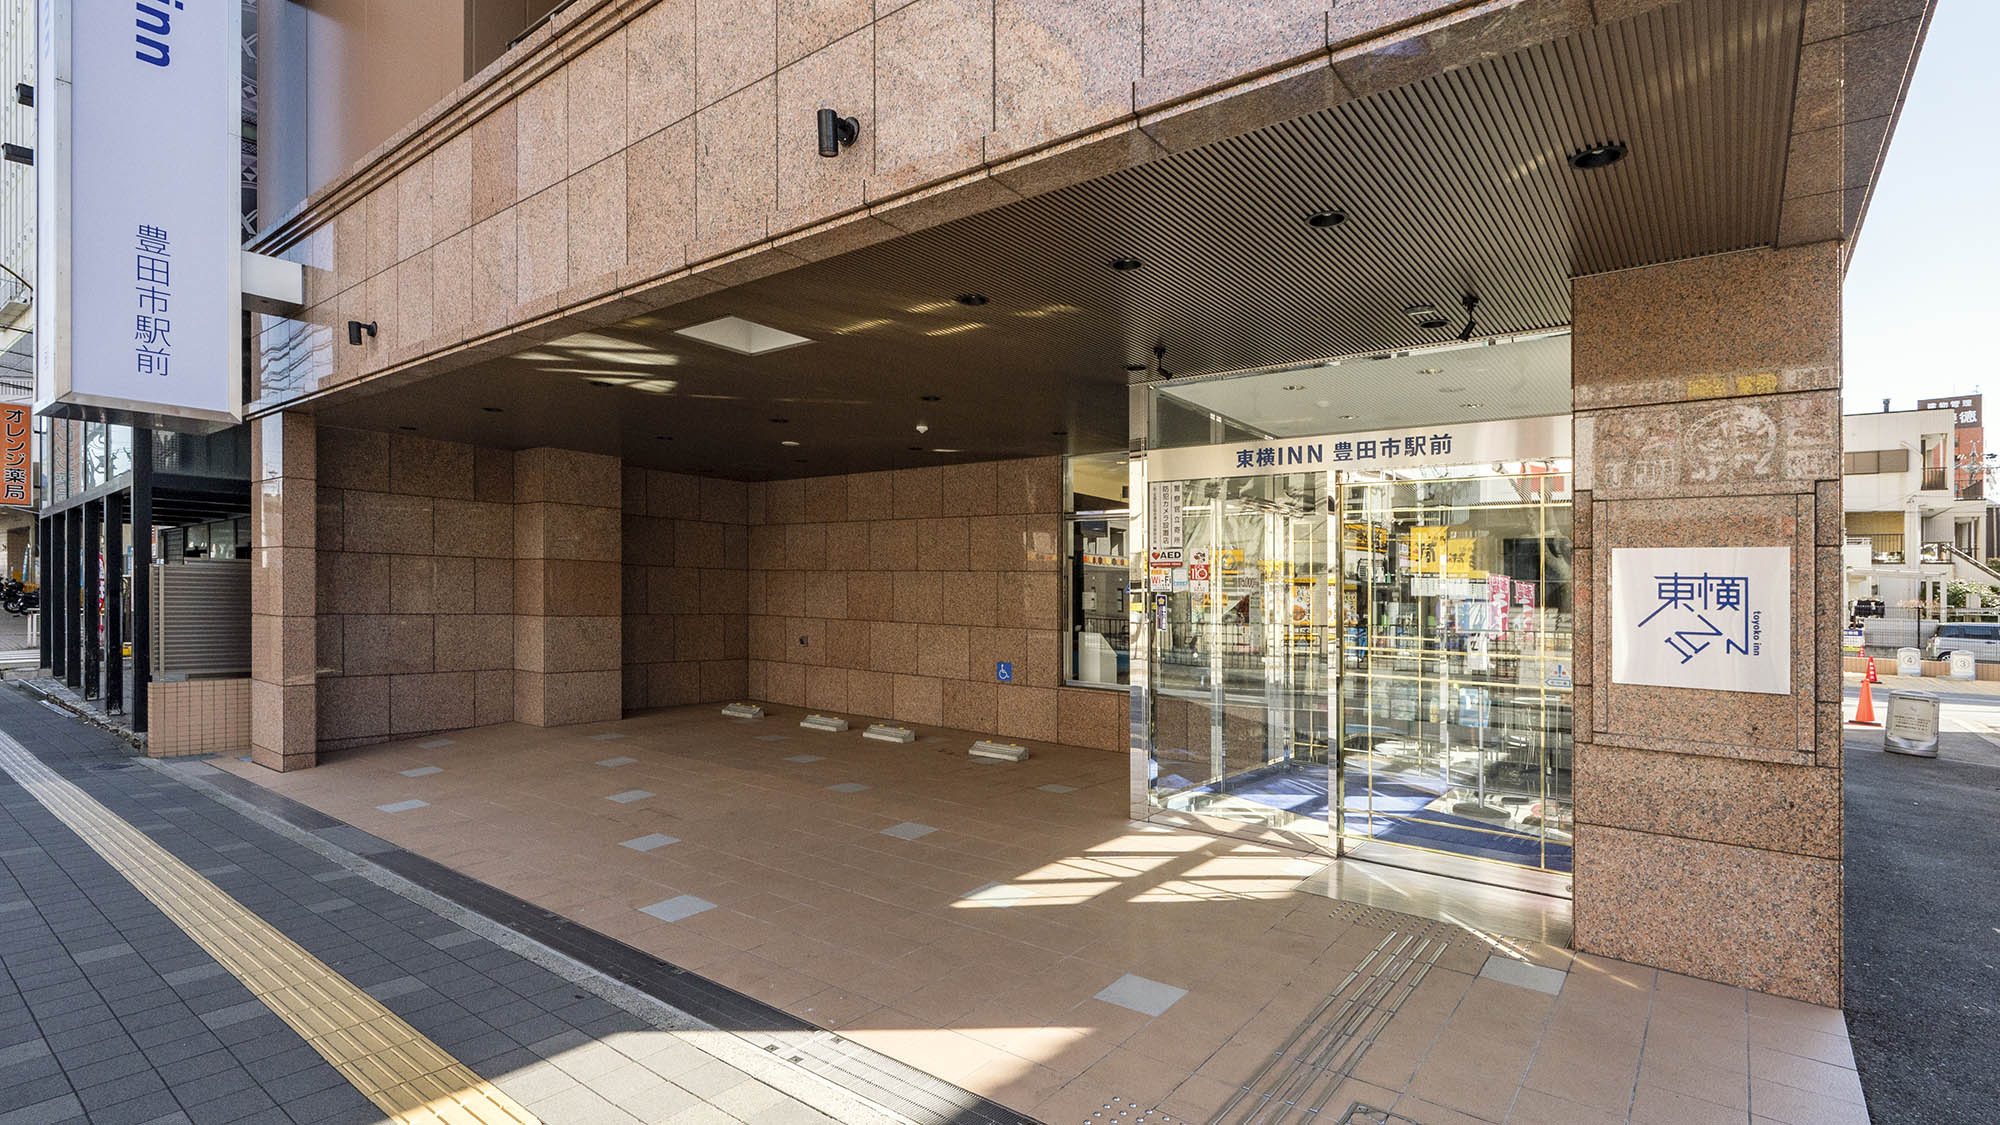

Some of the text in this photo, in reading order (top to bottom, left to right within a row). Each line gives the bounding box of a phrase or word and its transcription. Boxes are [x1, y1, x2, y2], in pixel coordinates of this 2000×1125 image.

[135, 224, 171, 376] 豊田市駅前
[5, 409, 25, 500] オレンジ薬局
[1236, 433, 1453, 468] 東横INN 豊田市駅前
[1160, 551, 1181, 559] AED
[1151, 575, 1172, 585] Wi-Fi
[1752, 611, 1762, 656] toyoko inn
